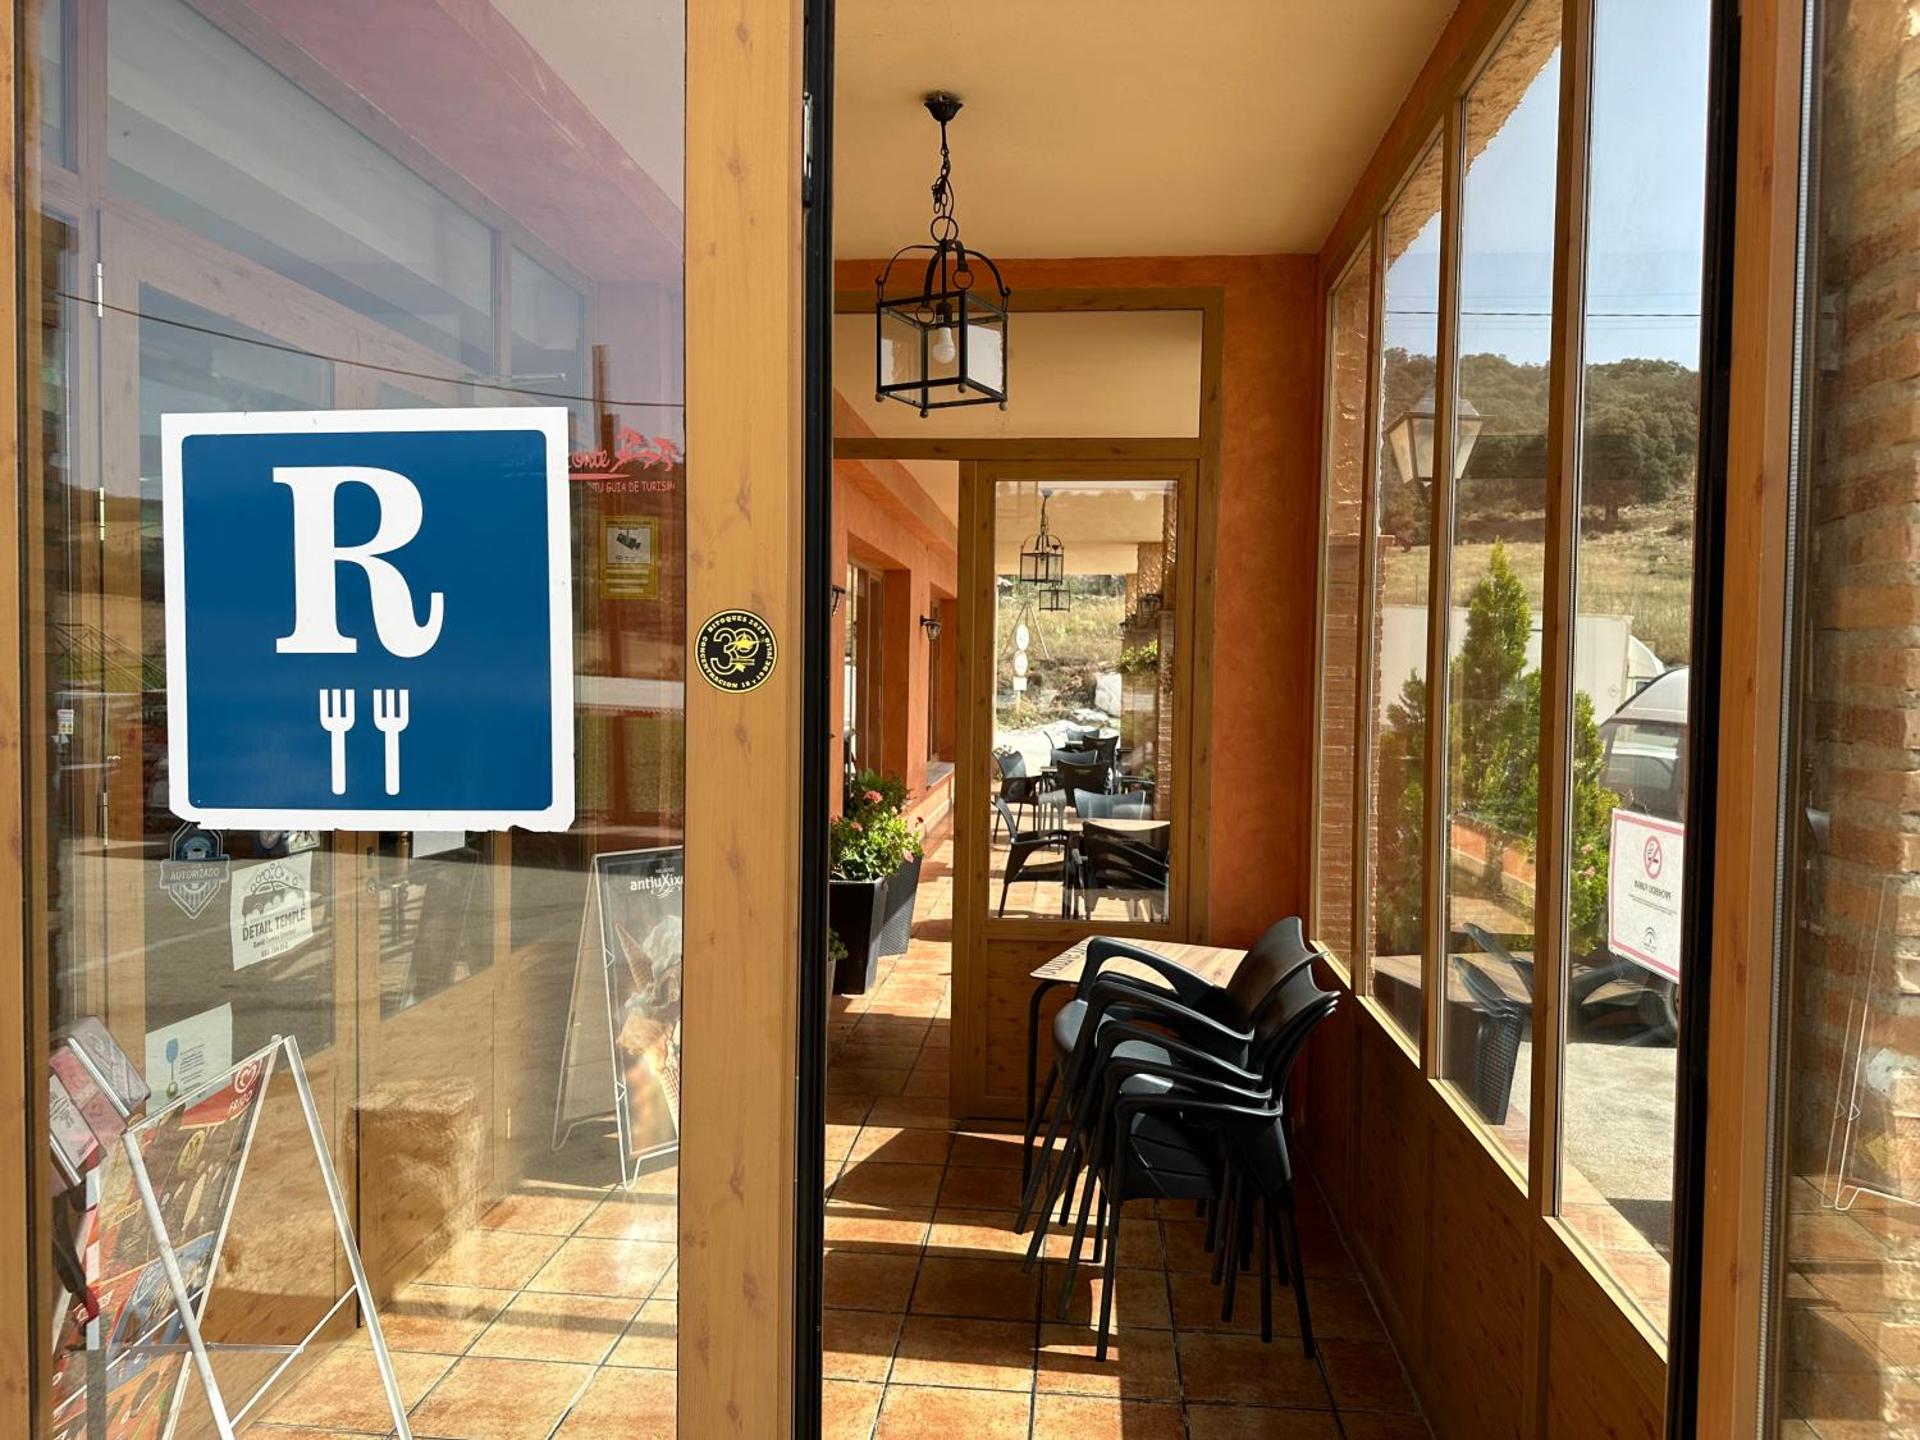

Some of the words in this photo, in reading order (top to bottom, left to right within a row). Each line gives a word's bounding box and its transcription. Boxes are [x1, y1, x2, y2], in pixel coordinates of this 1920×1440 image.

[628, 480, 640, 493] DE
[272, 466, 444, 658] R
[765, 637, 774, 660] JULIO
[762, 660, 772, 672] DE
[170, 867, 220, 881] AUTORIZADO
[242, 919, 273, 941] DETAIL
[275, 907, 306, 930] TEMPLE
